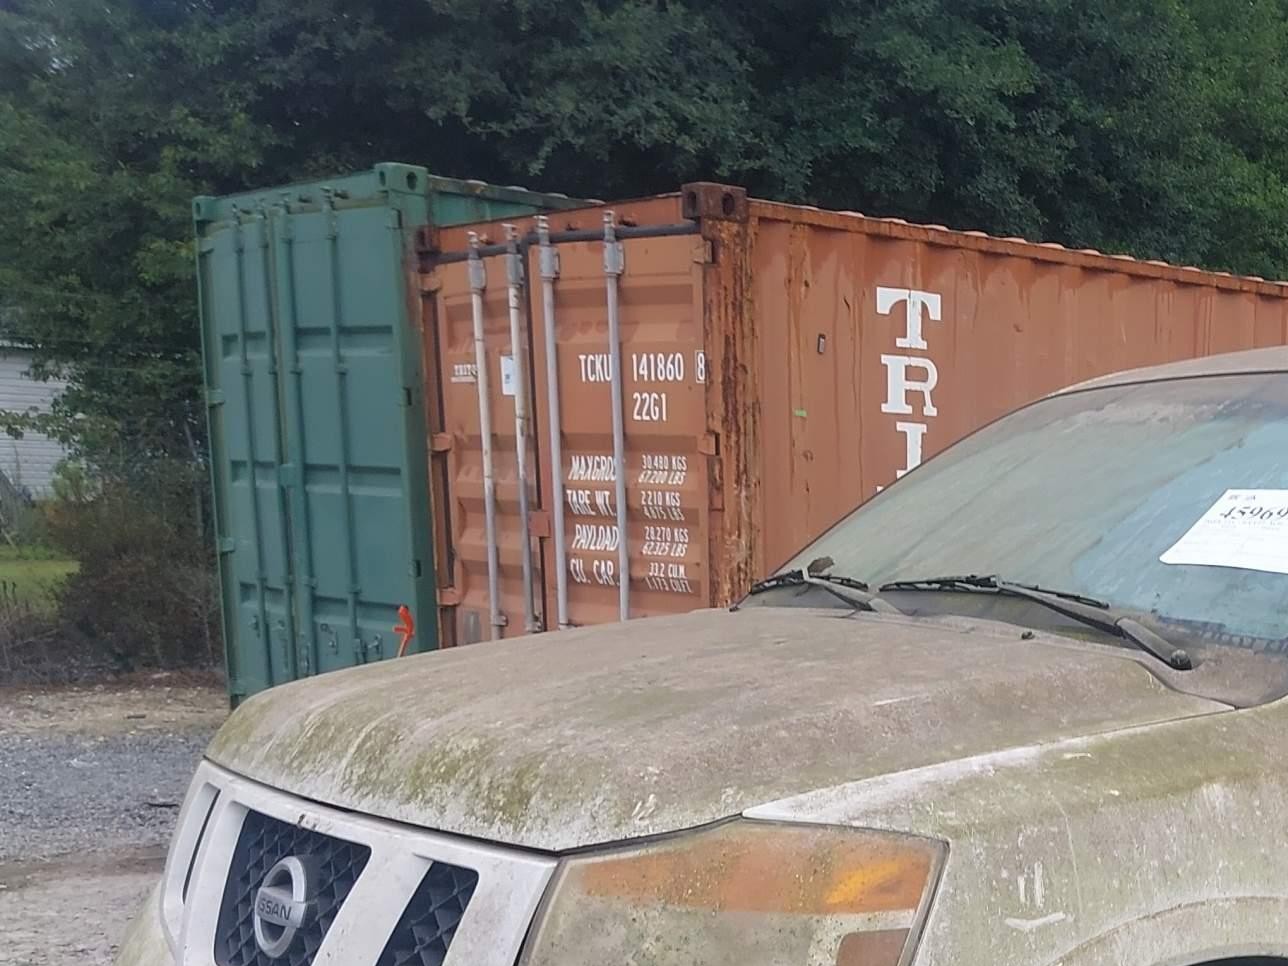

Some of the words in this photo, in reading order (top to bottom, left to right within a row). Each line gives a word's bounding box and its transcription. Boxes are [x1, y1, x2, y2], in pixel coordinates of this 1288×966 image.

[578, 353, 612, 382] TCKU
[632, 352, 684, 382] 141860
[696, 352, 705, 382] 8
[876, 286, 942, 486] TRI
[632, 392, 667, 421] 22G1
[671, 455, 687, 471] KGS
[566, 489, 596, 516] TARE
[665, 491, 681, 507] KGS
[571, 524, 619, 551] PAYLOAD
[673, 528, 689, 543] KGS
